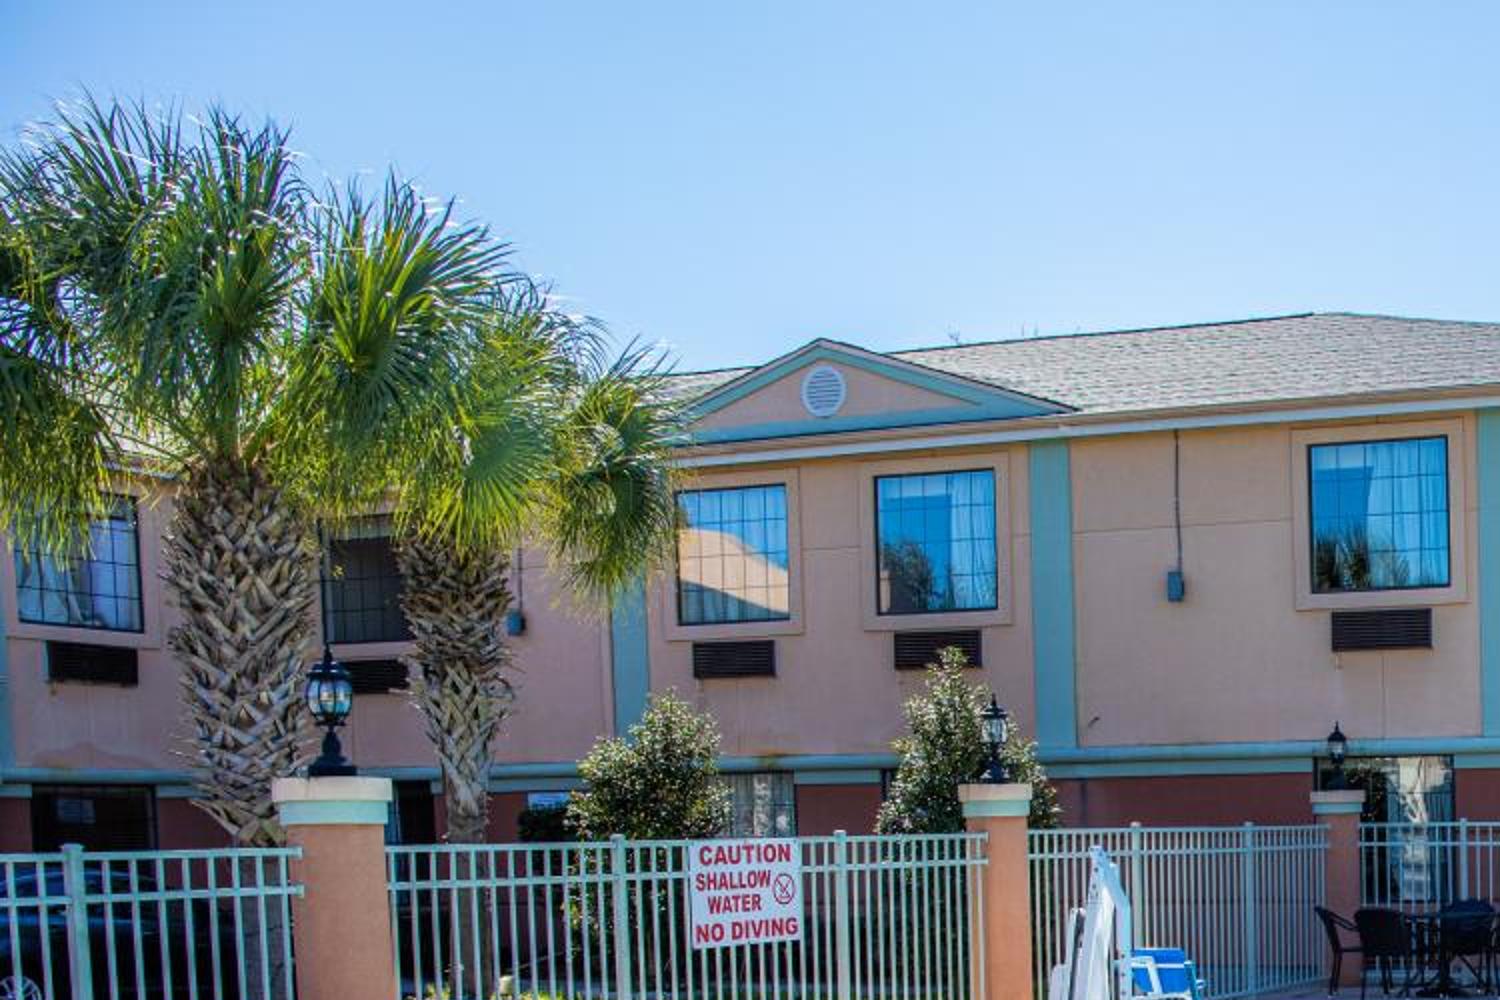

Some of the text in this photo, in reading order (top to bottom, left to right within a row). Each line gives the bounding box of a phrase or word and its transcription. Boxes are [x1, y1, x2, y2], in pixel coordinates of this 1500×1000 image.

[699, 843, 792, 866] CAUTION
[695, 869, 771, 891] SHALLOW
[707, 893, 762, 915] WATER
[695, 917, 798, 944] NO DIVING
